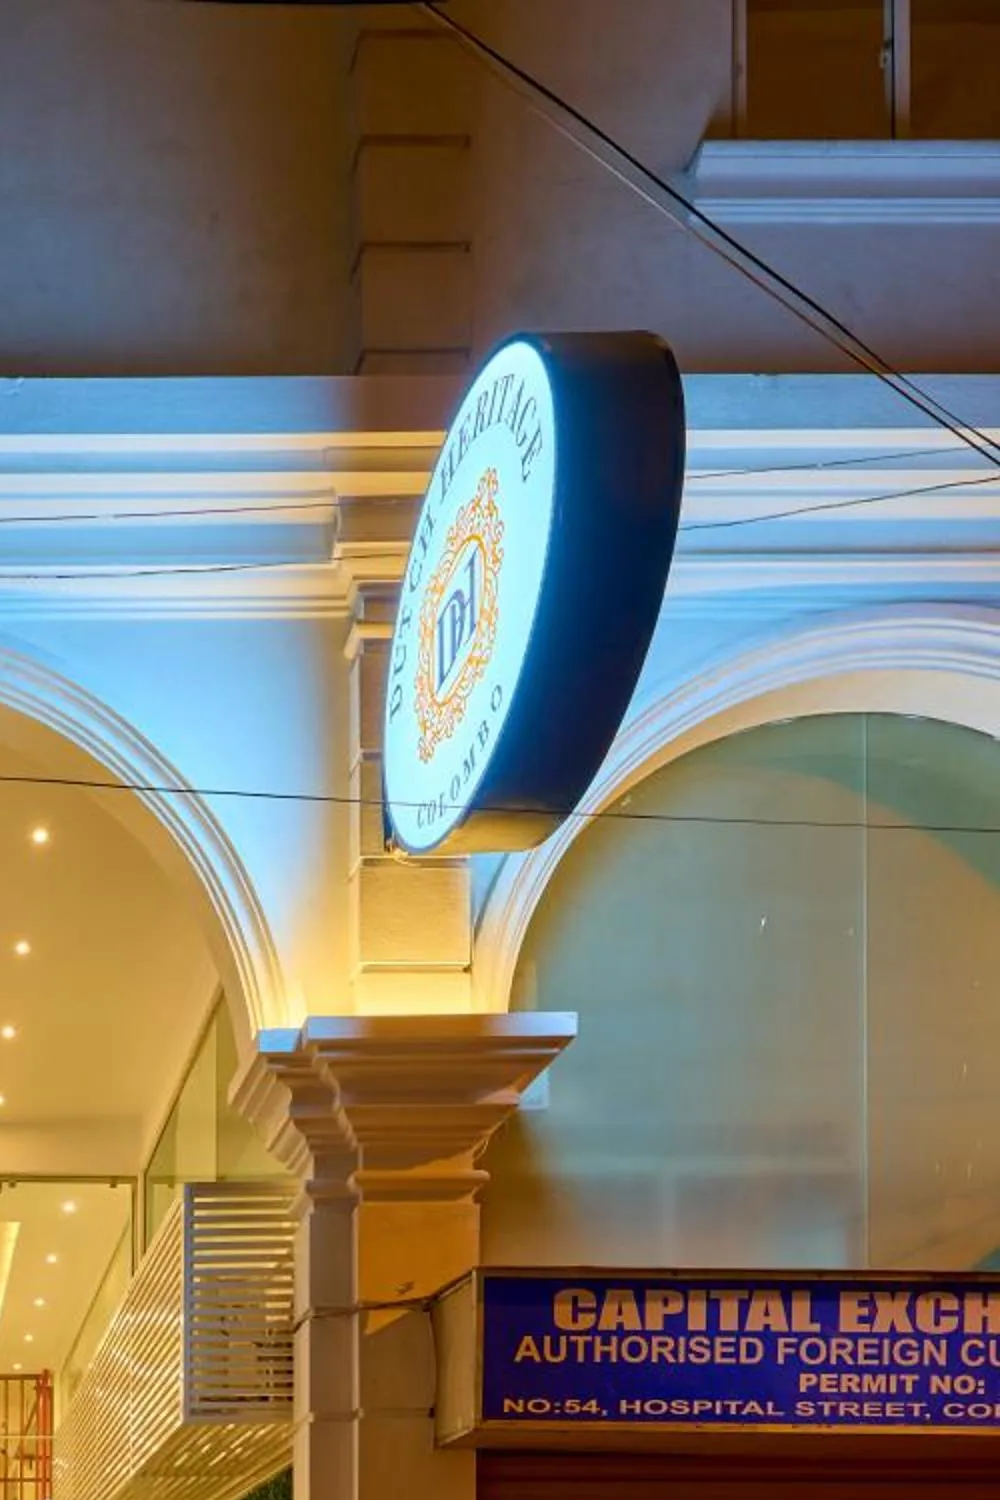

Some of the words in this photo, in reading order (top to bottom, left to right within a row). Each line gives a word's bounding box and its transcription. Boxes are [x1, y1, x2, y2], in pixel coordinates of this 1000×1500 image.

[390, 504, 437, 723] DUTCH
[440, 373, 543, 504] HERITAGE
[416, 684, 503, 830] COLOMBO
[553, 1288, 821, 1333] CAPITAL
[839, 1291, 1000, 1334] EXCH
[513, 1335, 765, 1364] AUTHORISED
[776, 1337, 948, 1367] FOREIGN
[799, 1373, 920, 1395] PERMIT
[930, 1374, 985, 1395] NO:
[503, 1398, 608, 1417] NO:54,
[619, 1399, 785, 1416] HOSPITAL
[794, 1401, 932, 1420] STREET,
[942, 1402, 1000, 1419] CO
